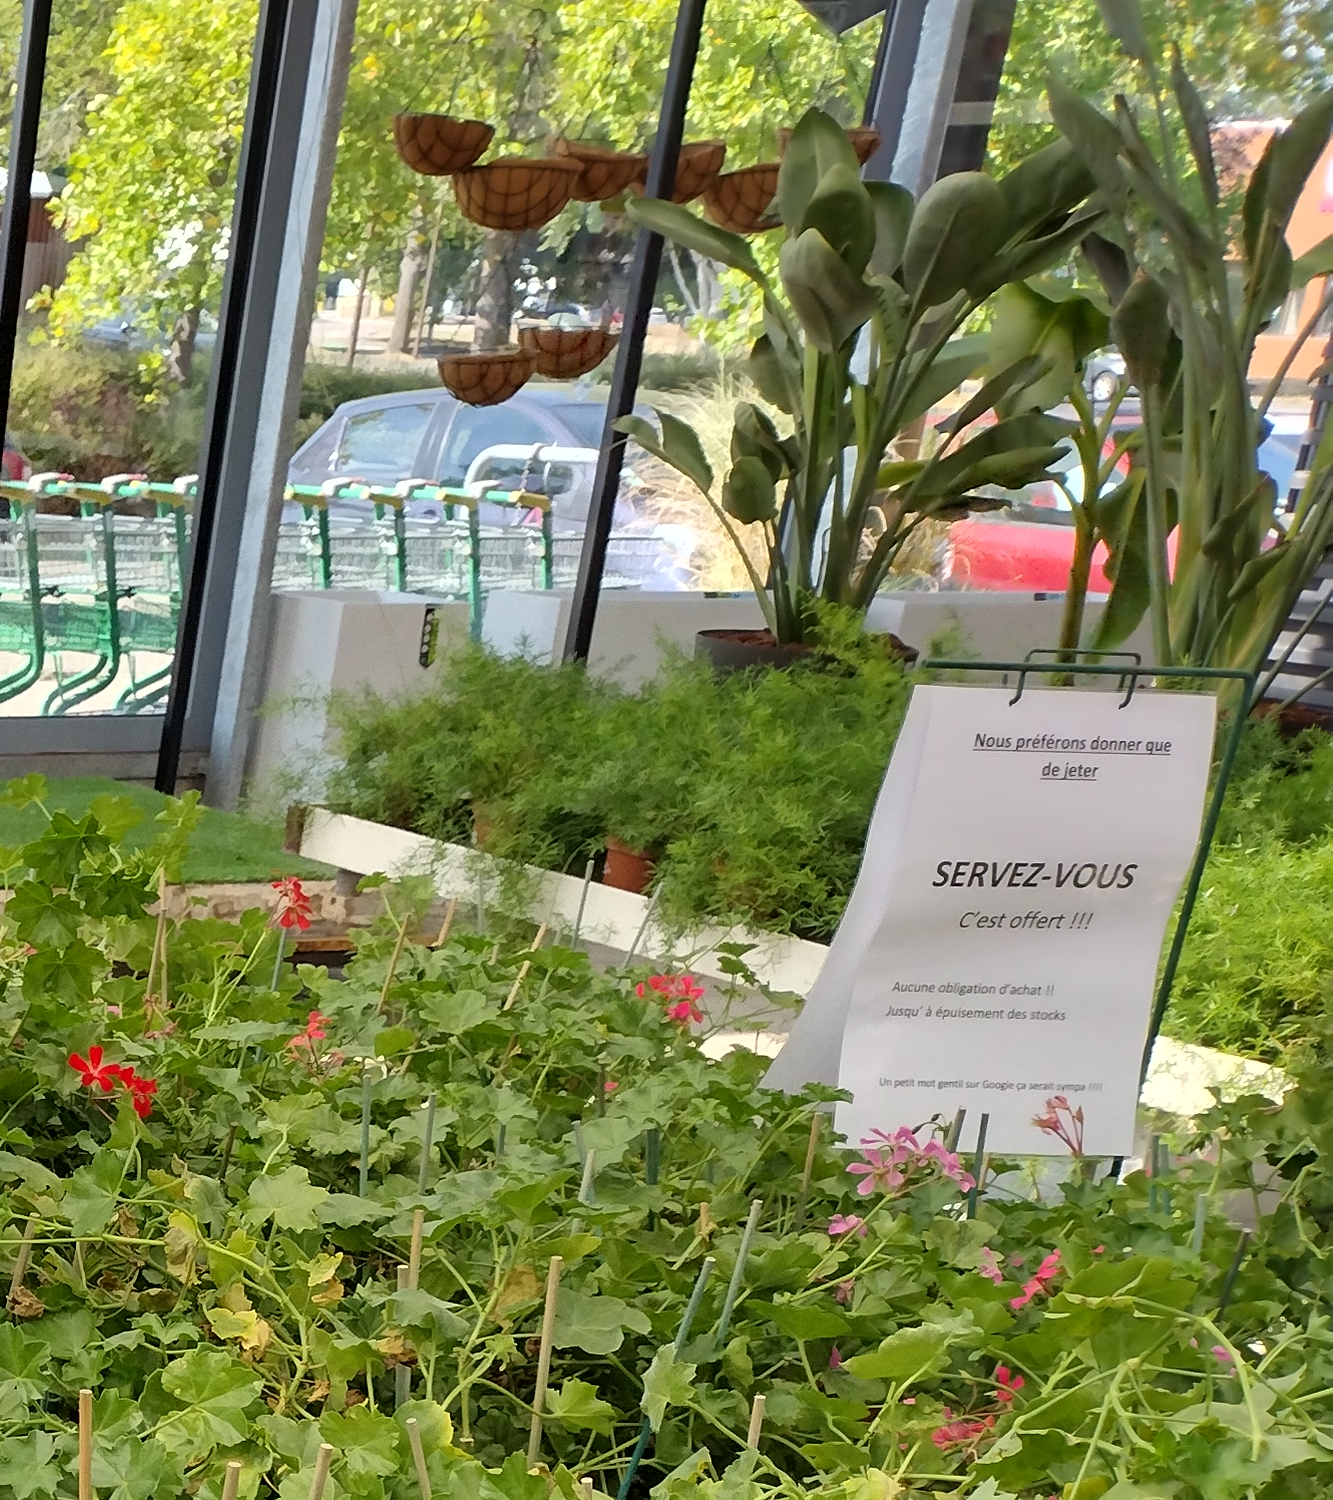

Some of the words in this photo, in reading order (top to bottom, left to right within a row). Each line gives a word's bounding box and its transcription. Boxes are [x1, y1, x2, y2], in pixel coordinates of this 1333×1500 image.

[974, 733, 1011, 748] Nous
[1015, 734, 1086, 752] préférons
[1090, 736, 1142, 751] donner
[1145, 740, 1172, 755] que
[1041, 762, 1060, 777] de
[1063, 762, 1099, 780] jeter
[932, 861, 1138, 889] SERVEZ-VOUS
[959, 911, 1006, 929] C'est
[1010, 911, 1065, 930] offert
[1069, 911, 1094, 930] !!!
[892, 981, 935, 993] Aucune
[938, 981, 996, 996] obligation
[999, 983, 1042, 996] d'achat
[1046, 985, 1055, 996] !!
[886, 1005, 923, 1019] Jusqu'
[926, 1006, 932, 1017] à
[935, 1006, 1004, 1020] épuisement
[1007, 1008, 1027, 1020] des
[1030, 1009, 1066, 1021] stocks
[879, 1077, 892, 1087] Un
[894, 1078, 915, 1088] petit
[918, 1079, 935, 1088] mot
[938, 1079, 963, 1090] gentil
[965, 1080, 980, 1088] sur
[982, 1080, 1014, 1091] Google
[1016, 1082, 1026, 1091] ça
[1029, 1081, 1054, 1090] serait
[1056, 1082, 1086, 1092] sympa
